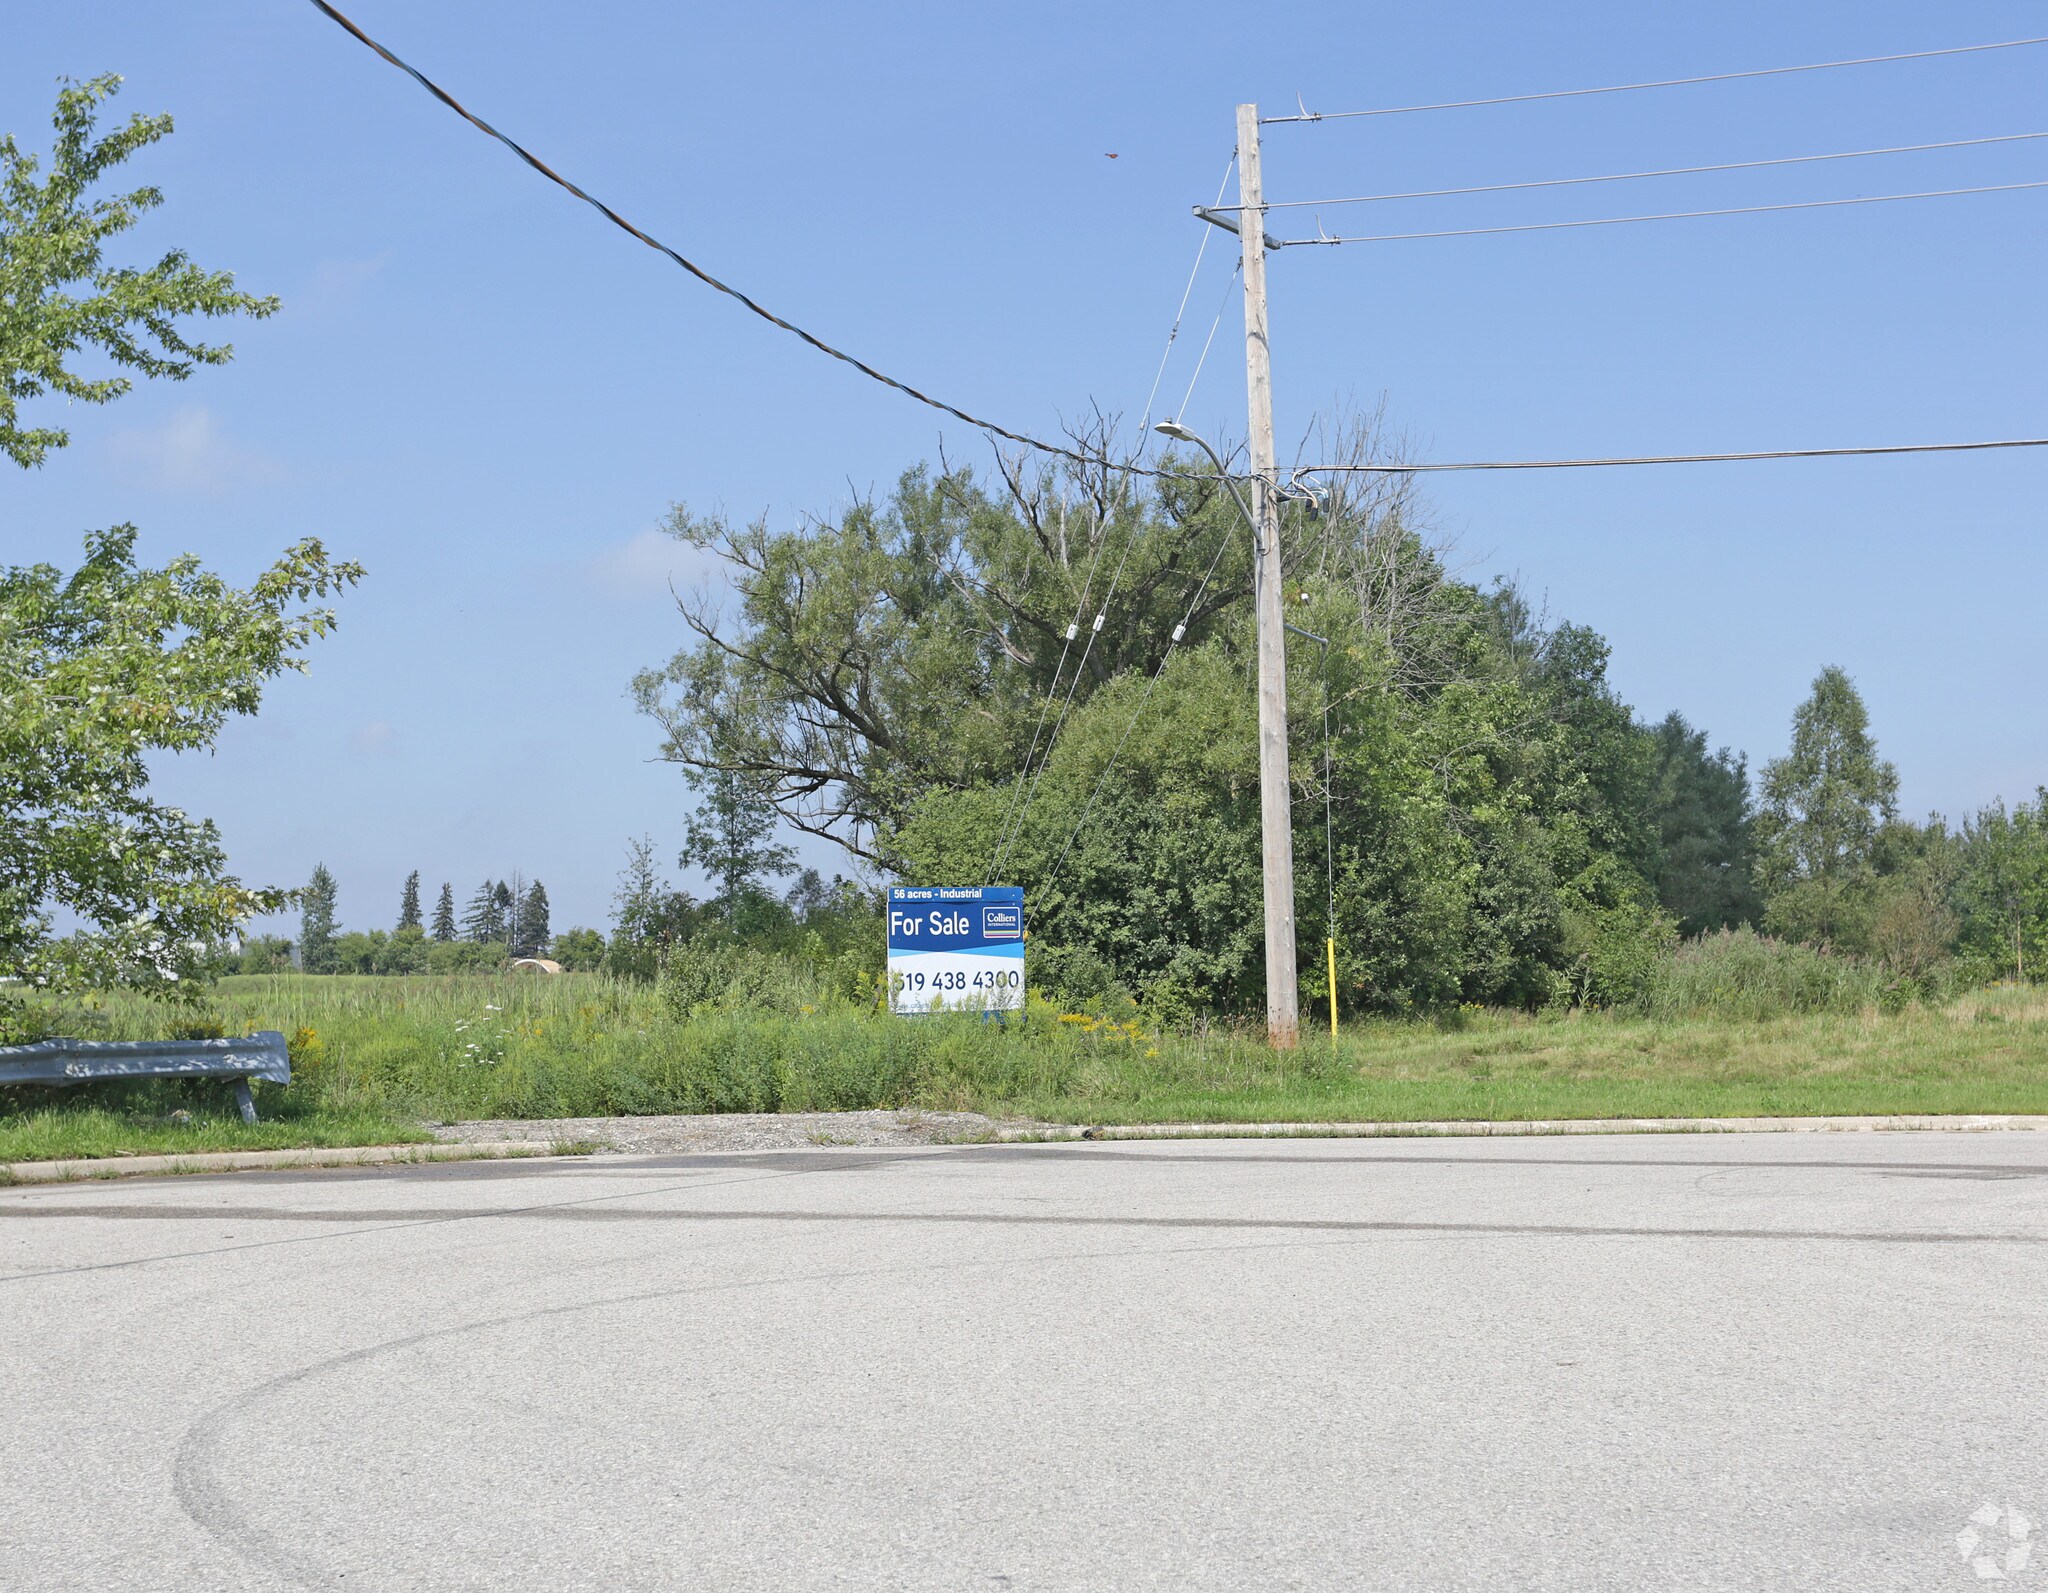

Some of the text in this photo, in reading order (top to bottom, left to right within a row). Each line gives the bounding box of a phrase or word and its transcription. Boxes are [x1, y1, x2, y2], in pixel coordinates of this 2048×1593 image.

[894, 889, 905, 899] 56
[908, 890, 932, 898] acres
[940, 888, 982, 899] Industrial
[891, 911, 970, 936] For Sale
[987, 912, 1016, 923] Colliers
[932, 971, 966, 991] 438
[973, 970, 1019, 990] 4300
